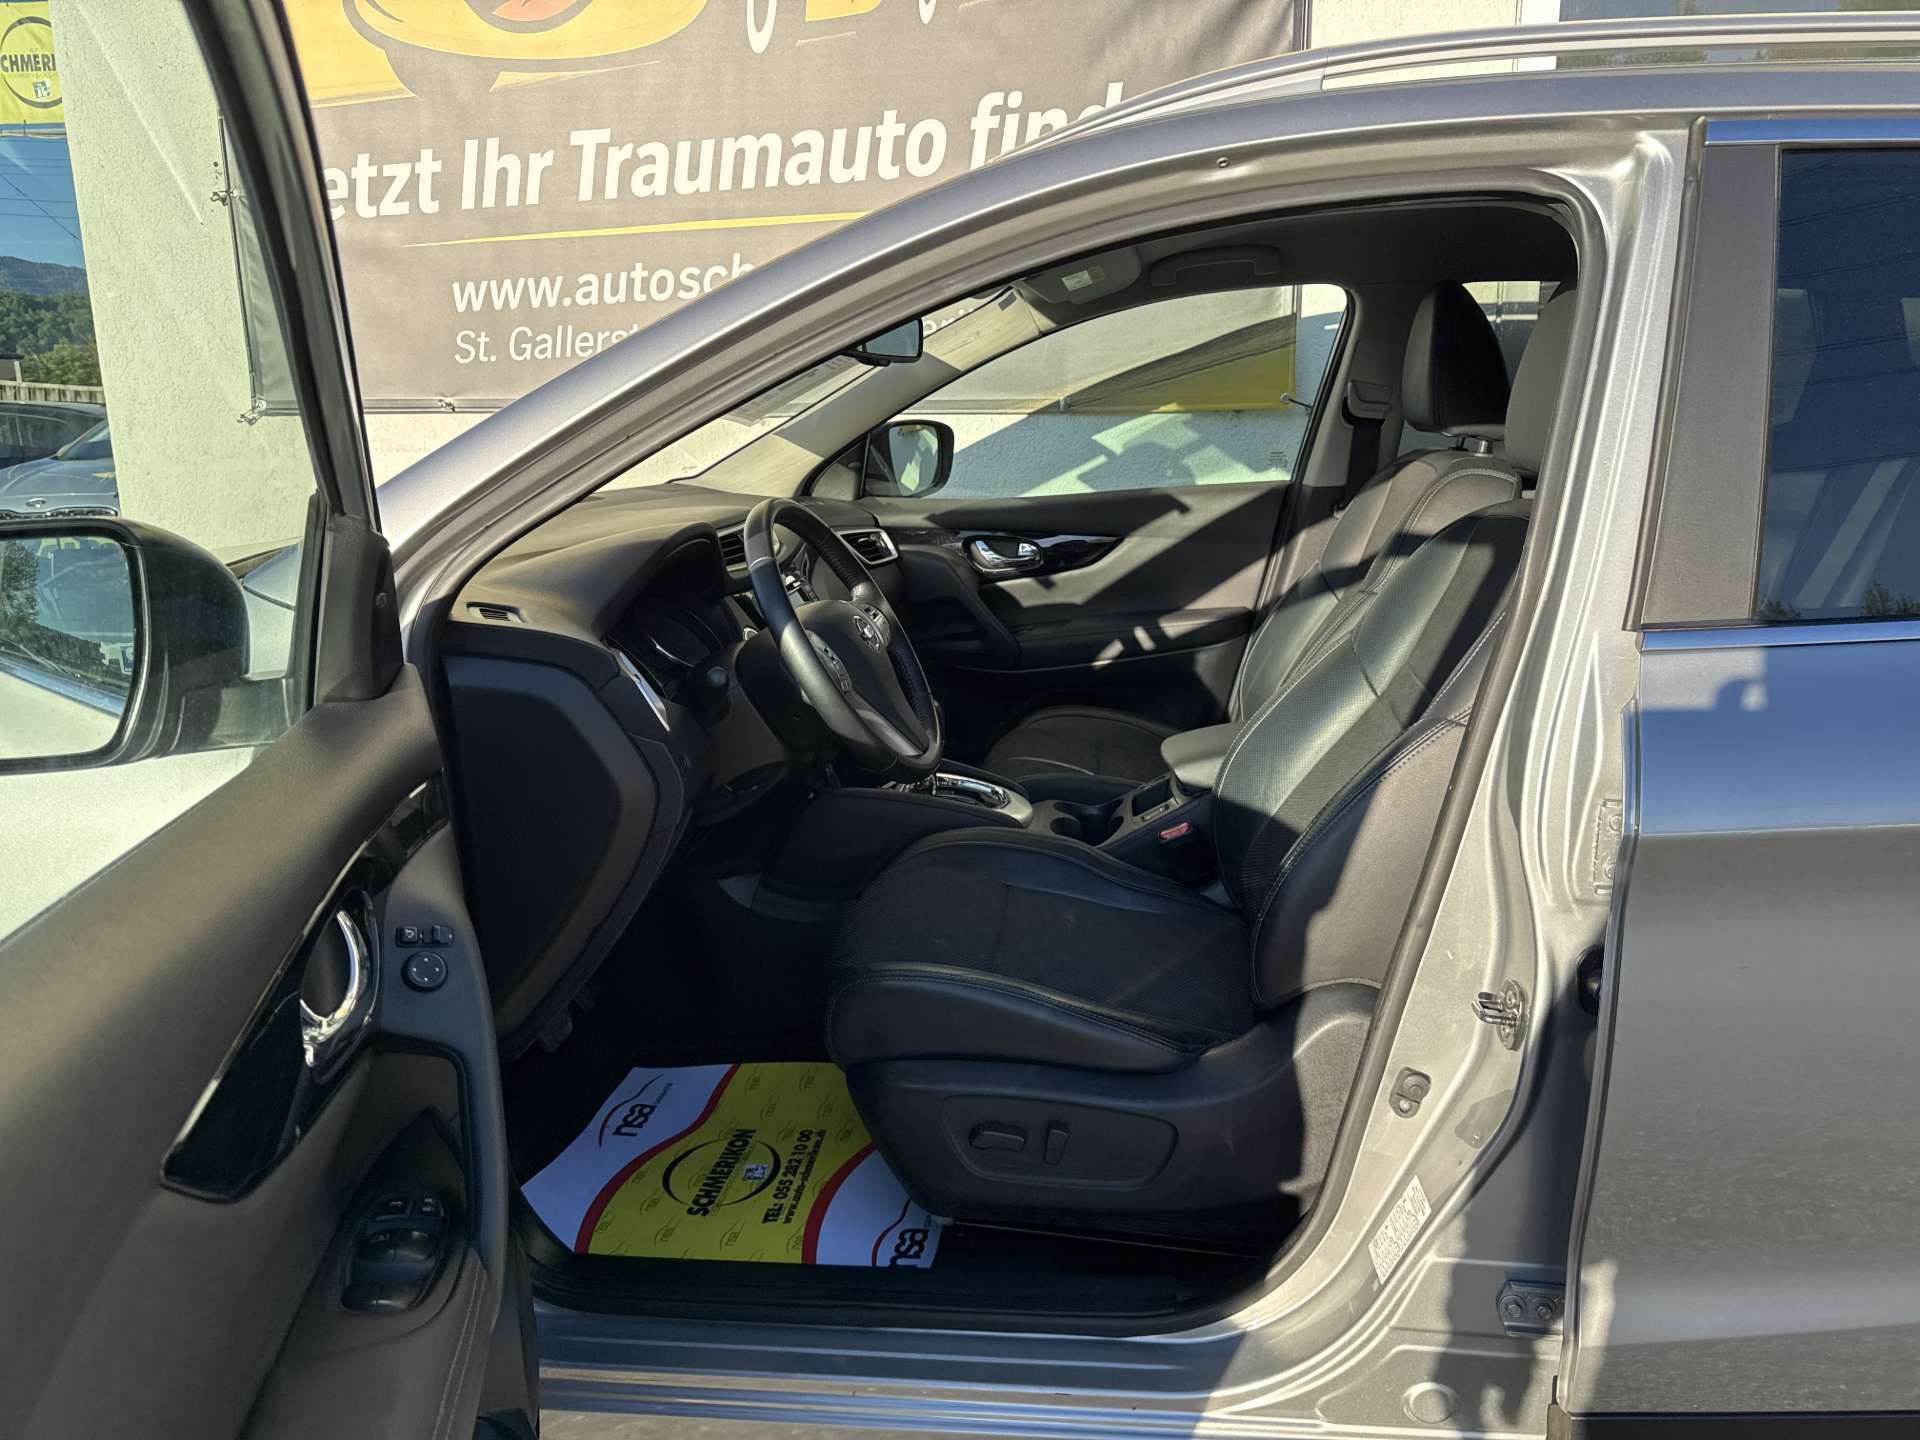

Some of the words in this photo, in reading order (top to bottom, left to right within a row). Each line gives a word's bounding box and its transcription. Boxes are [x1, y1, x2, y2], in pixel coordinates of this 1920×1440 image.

[461, 136, 554, 210] Ihr
[570, 109, 947, 202] Traumauto
[454, 330, 497, 364] St.
[612, 1103, 657, 1136] nsa
[797, 1129, 813, 1142] 00
[791, 1143, 808, 1156] 10
[686, 1129, 756, 1217] SCHMERIKON
[772, 1179, 793, 1199] 055
[761, 1203, 784, 1224] TEL:
[889, 1228, 929, 1268] nsa
